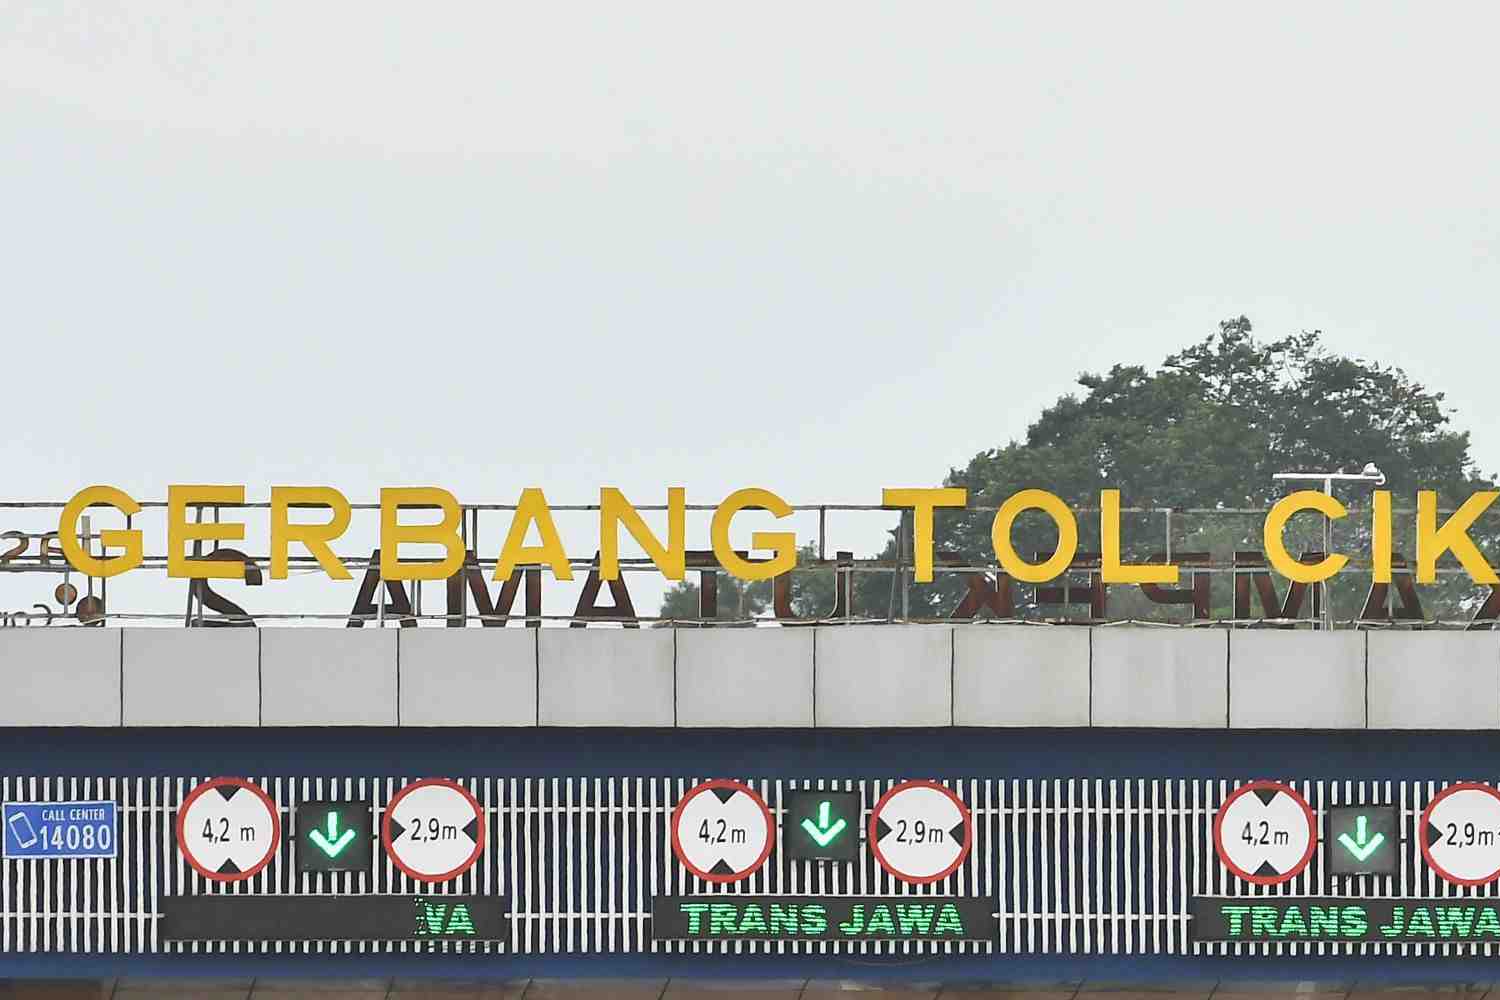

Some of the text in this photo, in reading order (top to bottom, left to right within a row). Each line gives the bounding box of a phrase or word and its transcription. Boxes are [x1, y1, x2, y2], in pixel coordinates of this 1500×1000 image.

[59, 485, 797, 581] GERBANG
[884, 488, 1179, 584] TOL
[42, 809, 105, 821] CALL CENTER
[40, 824, 111, 850] 14080
[680, 903, 964, 935] TRANS JAWA
[1221, 904, 1368, 937] TRANS
